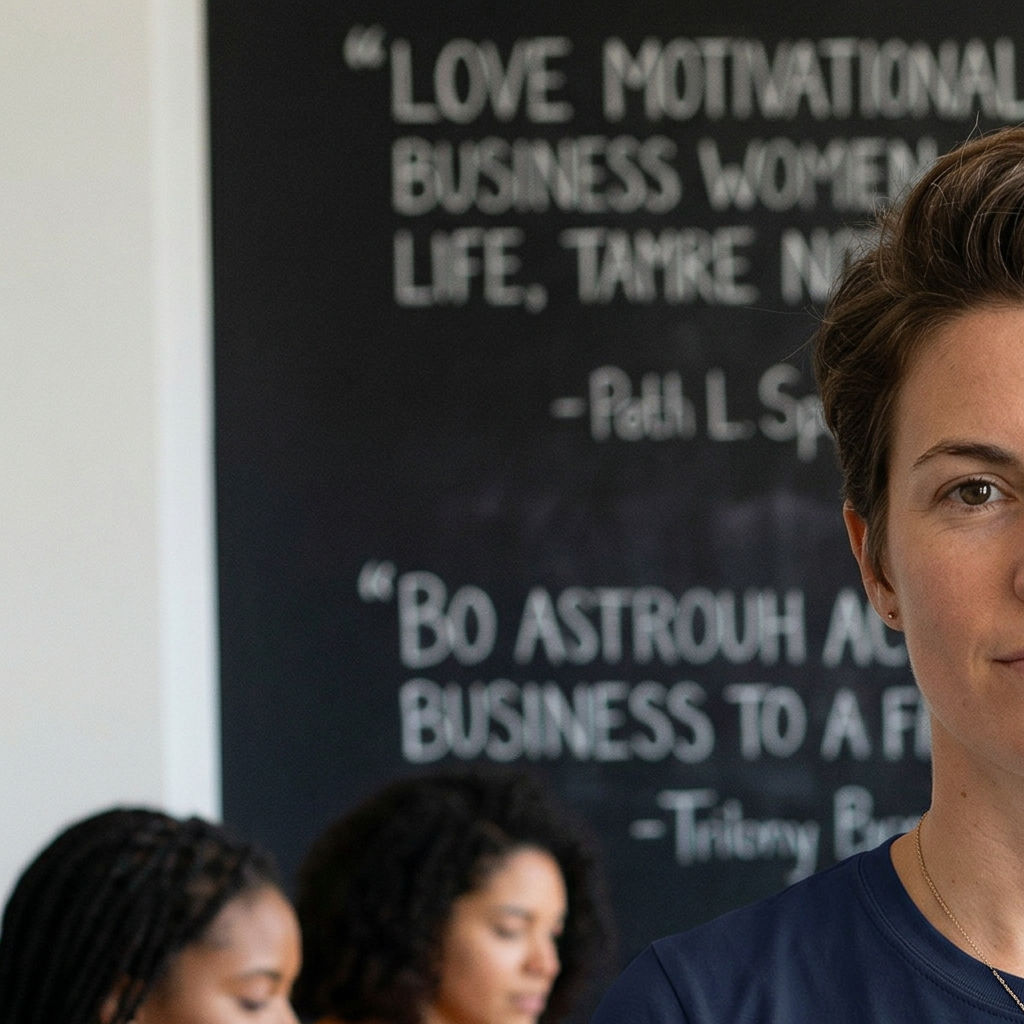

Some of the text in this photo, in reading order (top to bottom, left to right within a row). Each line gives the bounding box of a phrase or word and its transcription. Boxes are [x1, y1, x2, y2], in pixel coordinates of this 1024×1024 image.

[391, 136, 682, 215] BUSINESS
[398, 677, 716, 763] BUSINESS
[723, 683, 808, 761] TO
[819, 687, 872, 762] A
